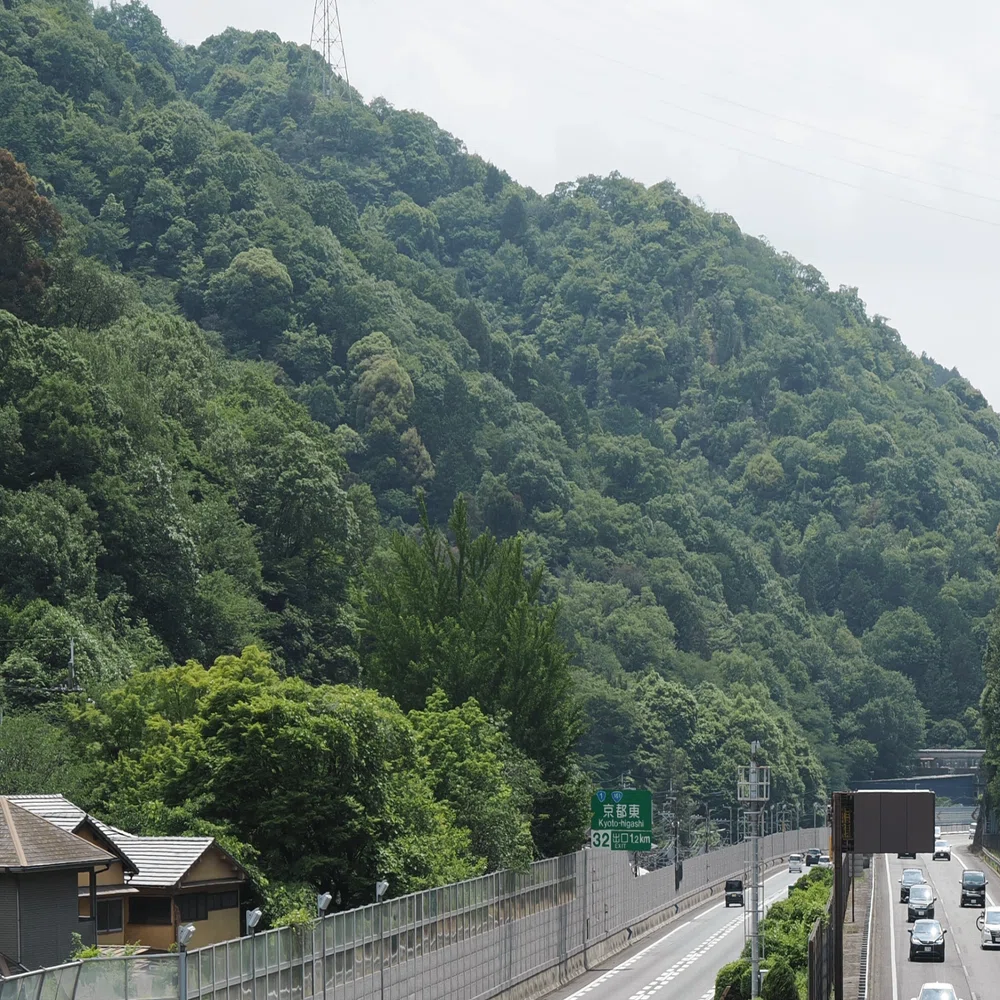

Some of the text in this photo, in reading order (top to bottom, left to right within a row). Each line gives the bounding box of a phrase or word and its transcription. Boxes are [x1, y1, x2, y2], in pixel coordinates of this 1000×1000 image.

[603, 803, 640, 819] 京都東
[599, 819, 644, 828] Kyoto-higashi
[593, 833, 610, 847] 32
[613, 833, 628, 843] 出口
